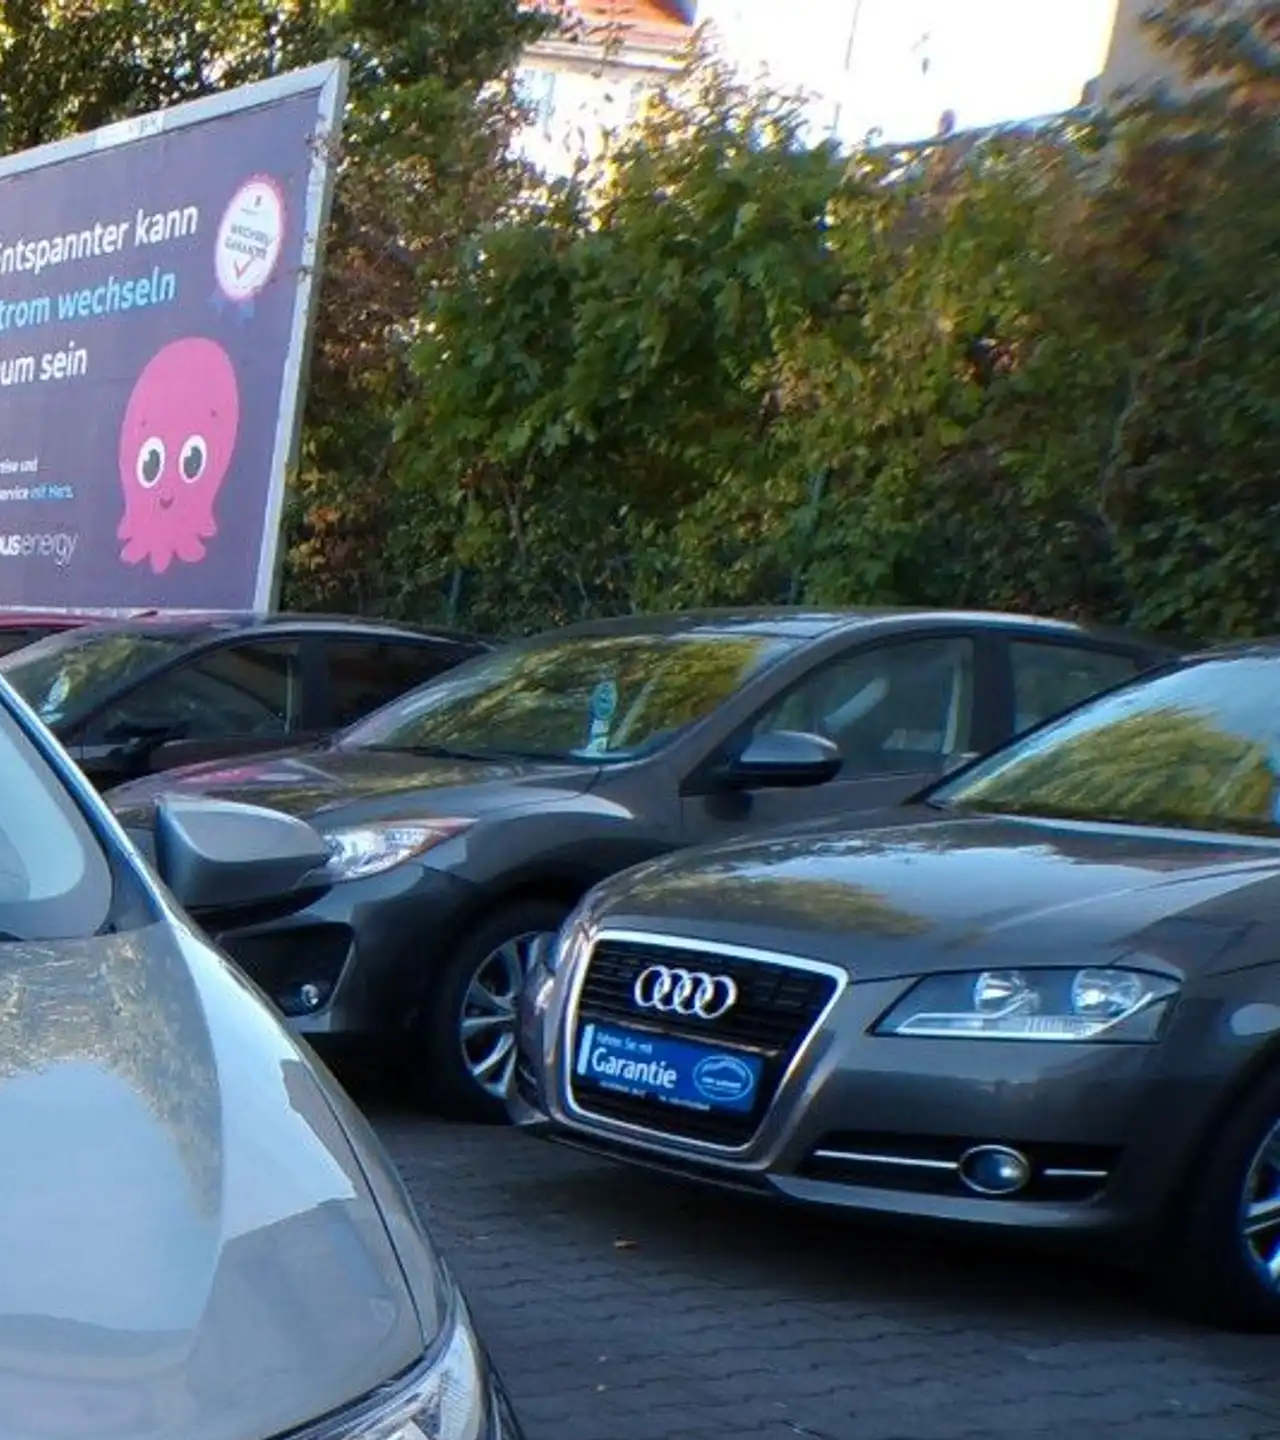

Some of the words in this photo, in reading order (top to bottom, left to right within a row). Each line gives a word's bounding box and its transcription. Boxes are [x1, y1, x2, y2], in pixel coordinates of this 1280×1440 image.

[133, 204, 199, 248] kann
[57, 265, 176, 321] wechseln
[40, 339, 88, 382] sein
[591, 1046, 678, 1089] Garantie
